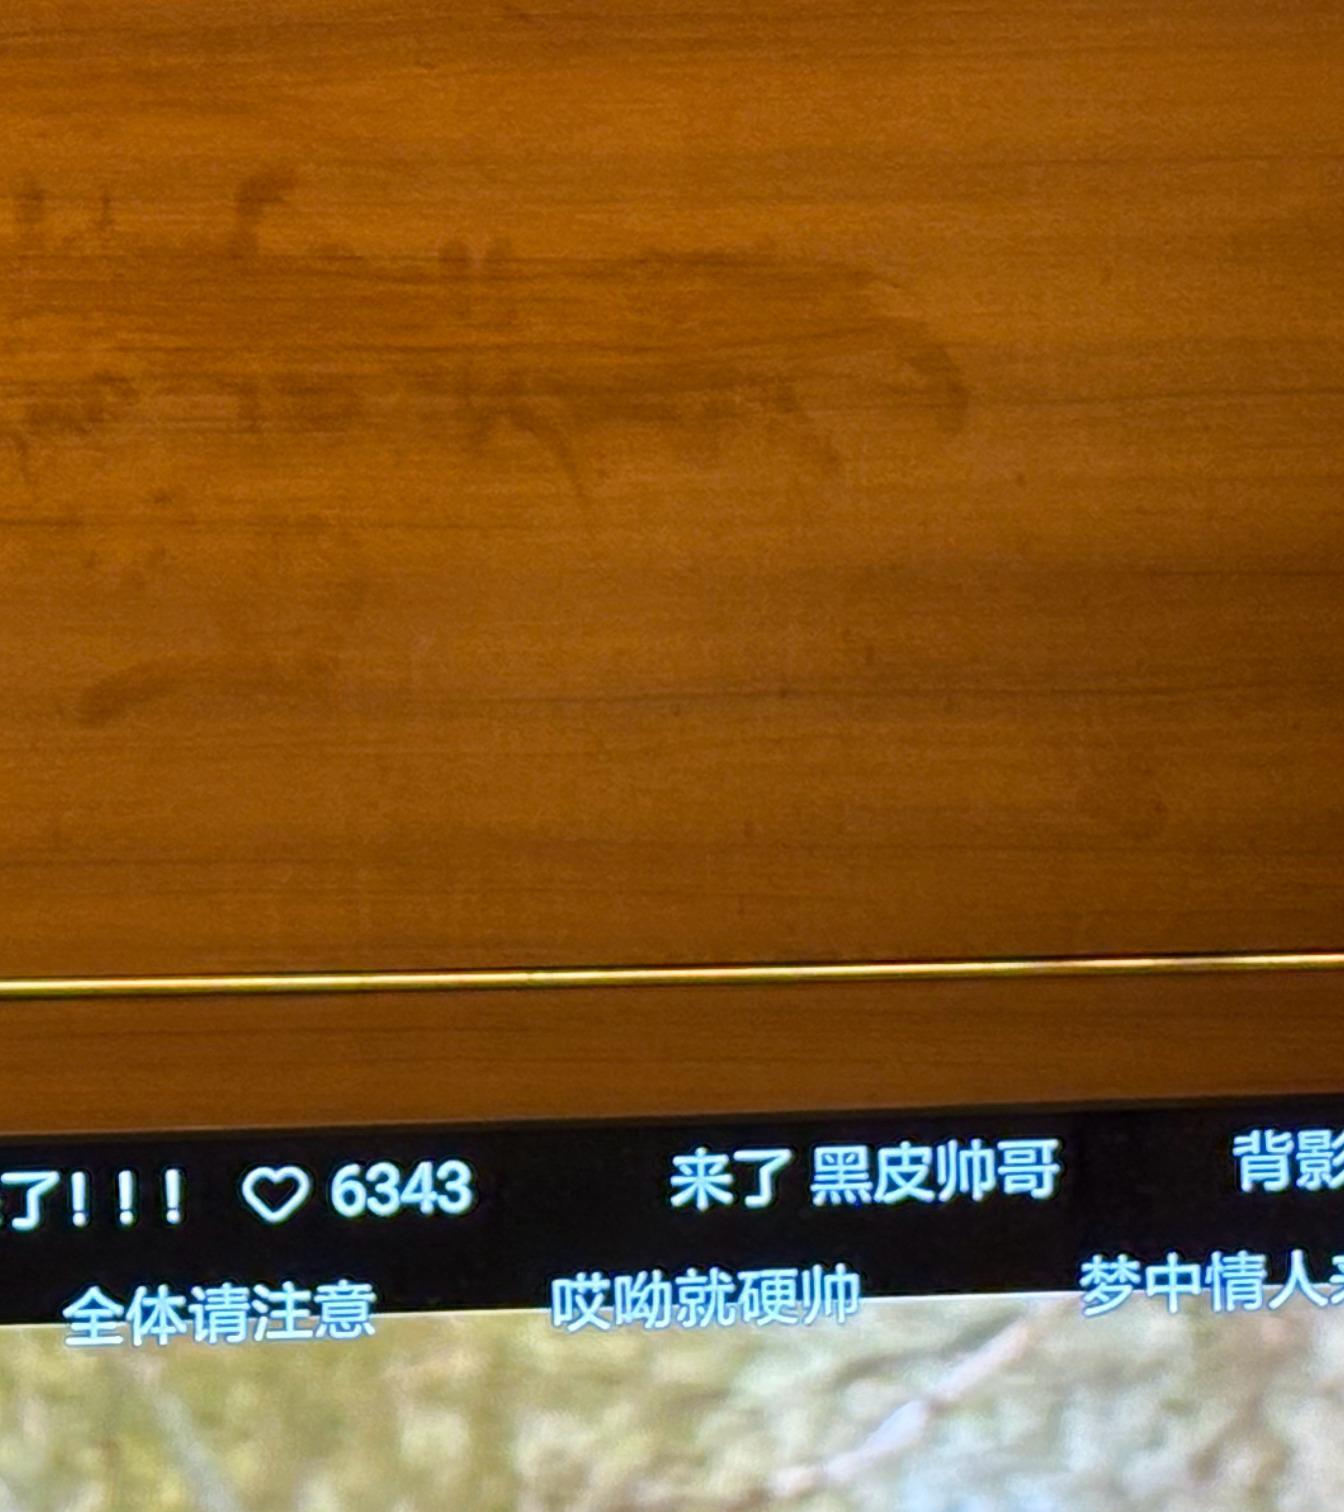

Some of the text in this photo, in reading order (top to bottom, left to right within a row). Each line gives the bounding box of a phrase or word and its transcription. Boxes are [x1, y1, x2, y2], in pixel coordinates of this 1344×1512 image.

[331, 1160, 473, 1217] 6343
[670, 1138, 1060, 1210] 来了 黑皮帅哥
[62, 1280, 376, 1347] 全体请注意
[551, 1263, 861, 1332] 哎呦就硬帅
